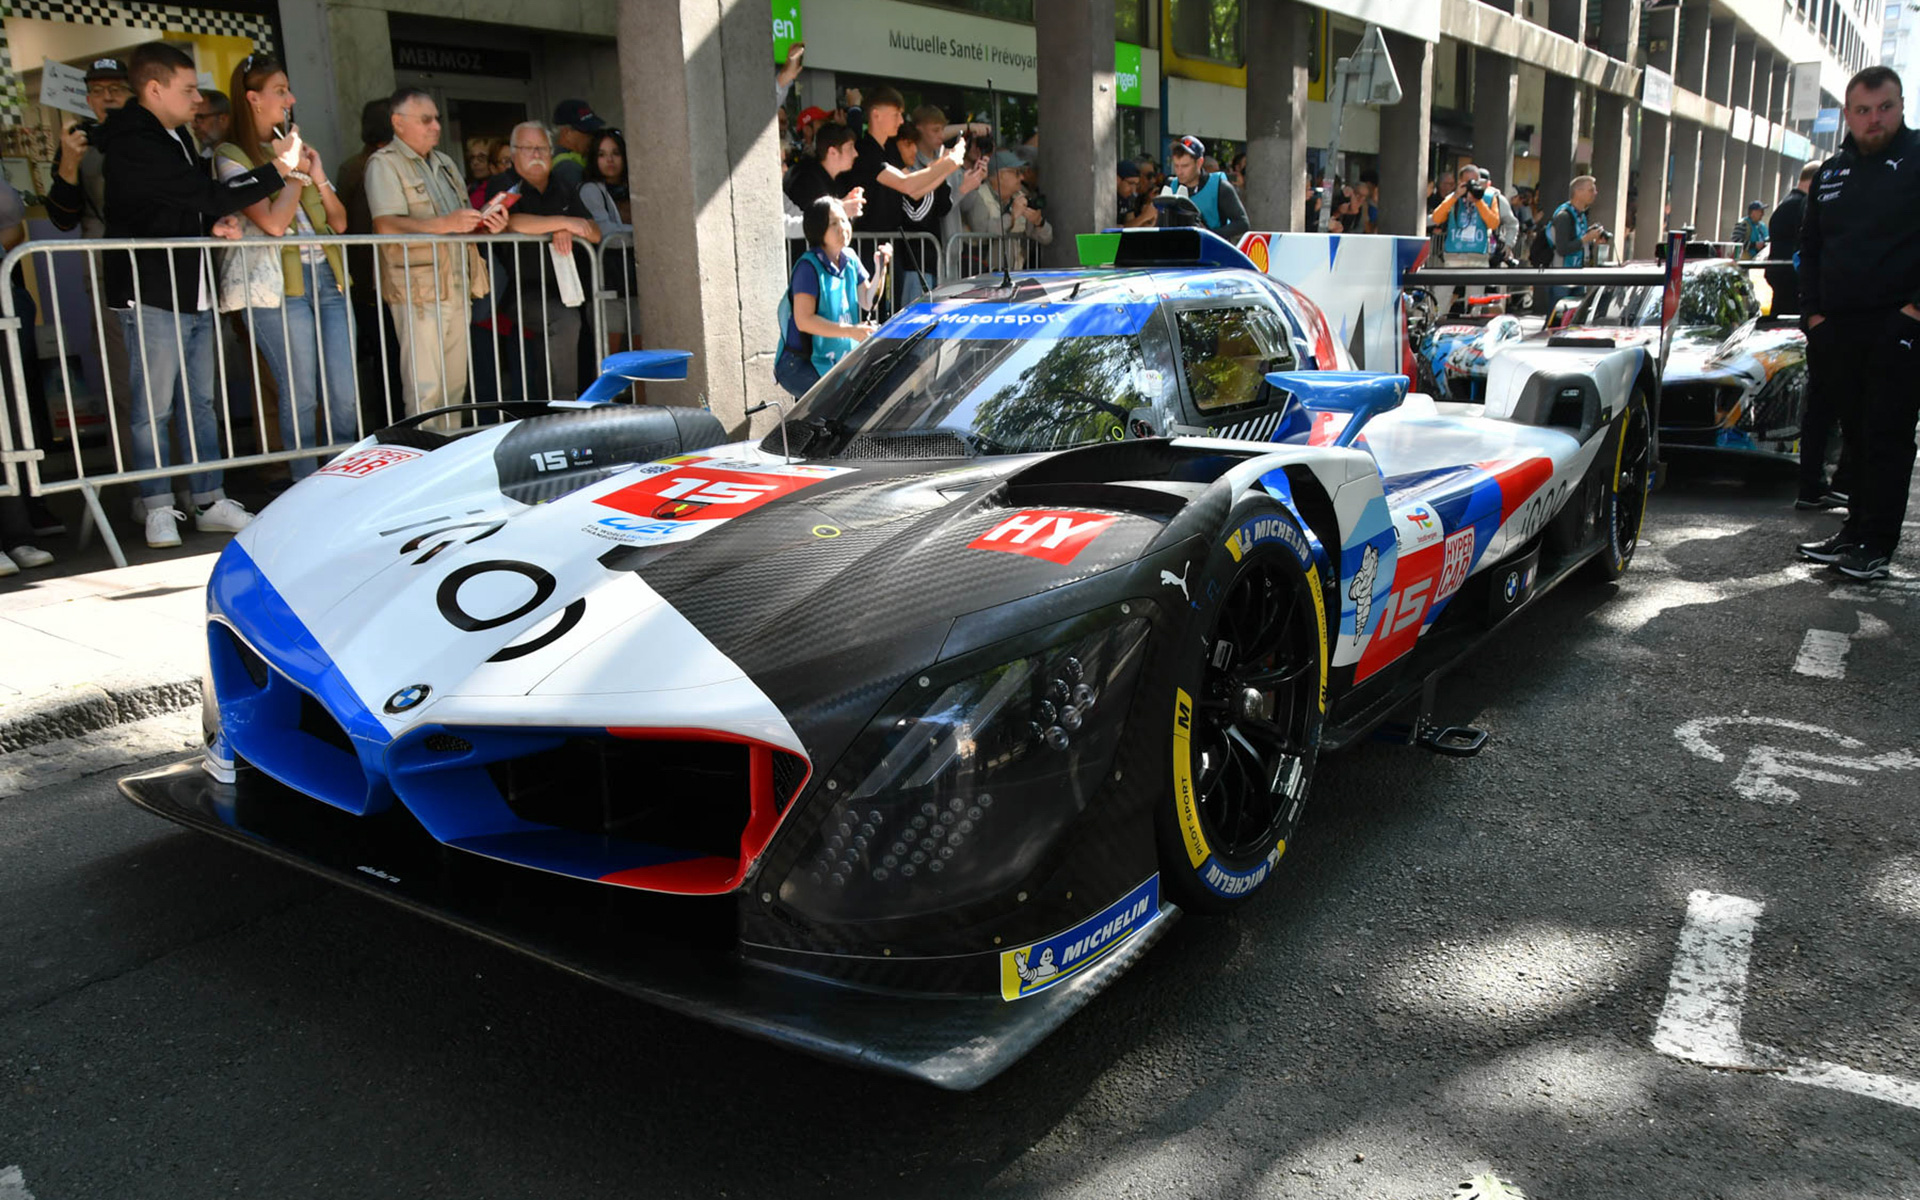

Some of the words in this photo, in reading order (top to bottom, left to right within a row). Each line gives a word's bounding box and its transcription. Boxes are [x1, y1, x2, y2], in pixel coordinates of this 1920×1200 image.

[399, 47, 483, 70] MERMOZ
[889, 30, 947, 55] Mutuelle
[949, 39, 983, 60] Santé
[937, 312, 1067, 326] Motorsport
[530, 450, 568, 472] 15
[656, 477, 779, 504] 15
[983, 515, 1105, 550] HY
[1254, 519, 1309, 562] MICHELIN
[1446, 532, 1473, 565] HYPER
[1438, 556, 1471, 598] CAR
[1379, 577, 1433, 641] 15
[1181, 777, 1194, 822] SPORT
[1188, 824, 1202, 856] PILOT
[1205, 863, 1268, 894] MICHELIN
[1062, 895, 1150, 966] MICHELIN
